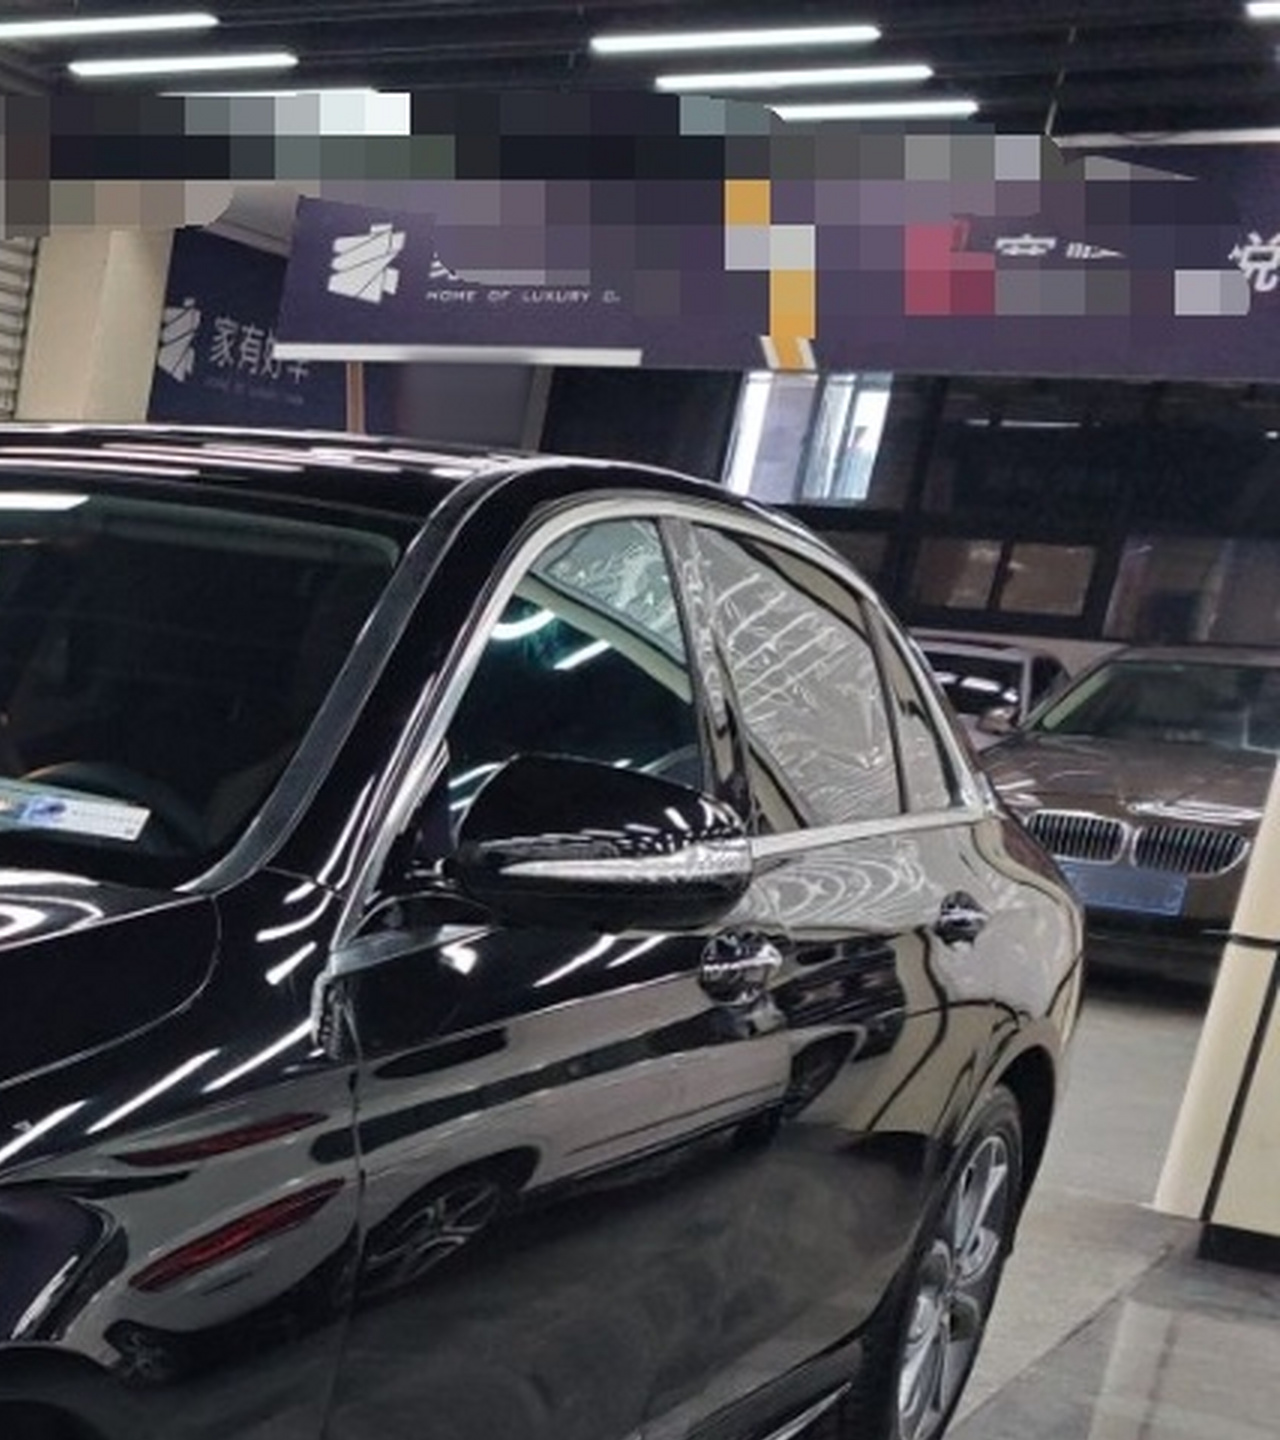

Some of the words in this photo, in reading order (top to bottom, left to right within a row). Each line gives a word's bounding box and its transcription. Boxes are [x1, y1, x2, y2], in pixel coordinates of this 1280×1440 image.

[425, 290, 477, 303] HOME
[487, 290, 511, 303] OF
[522, 290, 591, 303] LUXURY
